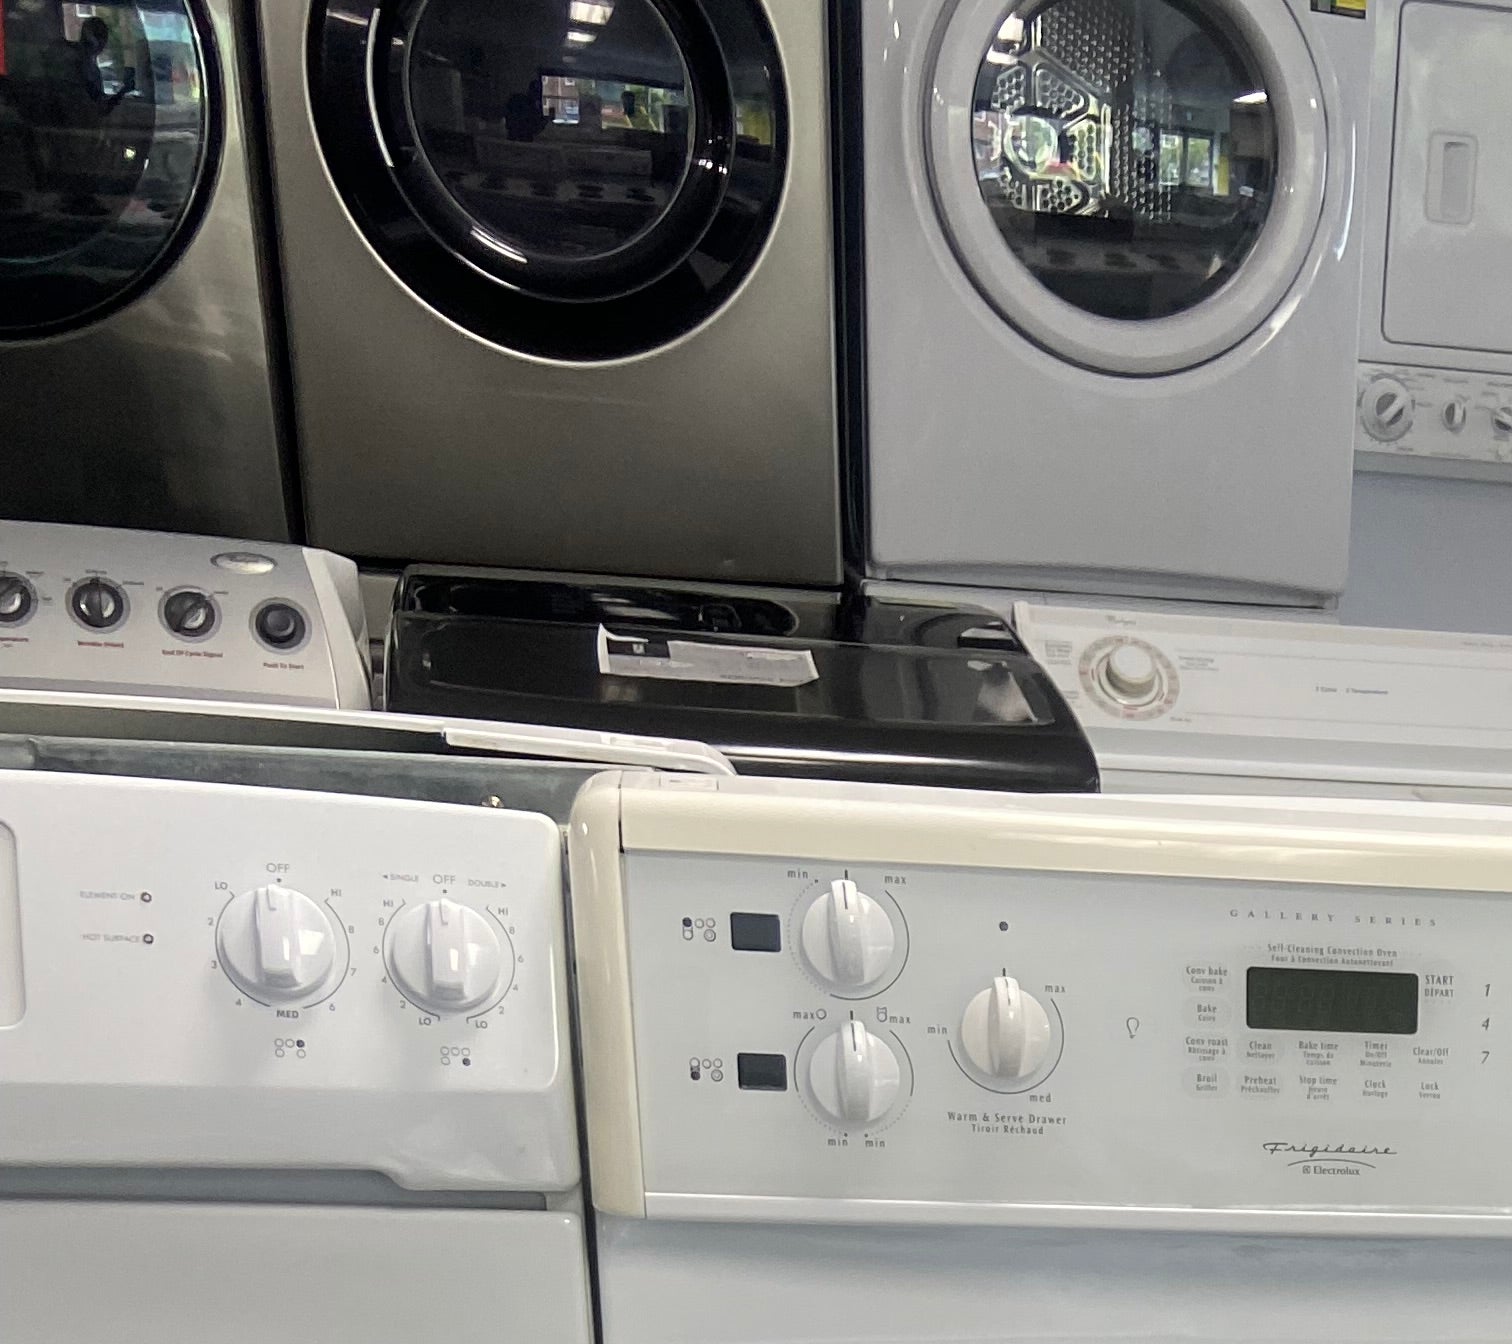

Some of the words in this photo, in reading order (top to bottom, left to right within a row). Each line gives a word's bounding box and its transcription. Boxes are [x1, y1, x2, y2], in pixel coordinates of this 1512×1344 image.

[266, 863, 290, 873] OFF
[787, 870, 808, 879] min
[390, 874, 419, 882] SINGLE
[432, 874, 456, 884] OFF
[468, 879, 499, 888] DOUBLE
[884, 875, 907, 885] max
[214, 881, 228, 890] LO
[330, 888, 342, 897] HI
[498, 907, 509, 916] HI
[207, 917, 214, 926] 2
[1229, 907, 1336, 922] GALLERY
[1354, 914, 1437, 927] SERIES
[1376, 948, 1398, 958] Oven
[1186, 966, 1205, 976] Conv
[1208, 967, 1228, 976] bake
[1425, 974, 1454, 986] START
[1045, 984, 1066, 993] max
[1484, 983, 1491, 998] 1
[1197, 1004, 1217, 1013] Bake
[276, 1010, 299, 1019] MED
[792, 1011, 815, 1020] max
[418, 1017, 432, 1026] LO
[889, 1016, 911, 1024] max
[1481, 1017, 1490, 1031] 4
[475, 1020, 488, 1030] LO
[927, 1024, 948, 1034] min
[1186, 1036, 1205, 1046] Conv
[1249, 1041, 1272, 1050] Clean
[1298, 1041, 1318, 1050] Bake
[1321, 1042, 1339, 1050] time
[1364, 1041, 1388, 1050] Timer
[1413, 1047, 1449, 1057] Clear/Off
[1481, 1050, 1490, 1065] 7
[1197, 1074, 1217, 1083] Broil
[1244, 1075, 1276, 1085] Preheat
[1299, 1076, 1317, 1086] Stop
[1319, 1076, 1338, 1085] time
[1364, 1080, 1386, 1089] Clock
[1421, 1082, 1439, 1091] Lock
[1029, 1093, 1052, 1103] med
[947, 1111, 978, 1122] Warm
[982, 1112, 991, 1122] &
[995, 1113, 1024, 1123] Serve
[1028, 1114, 1067, 1125] Drawer
[971, 1124, 999, 1133] Tiroir
[827, 1138, 848, 1147] min
[865, 1139, 885, 1148] min
[1262, 1142, 1398, 1158] Frigidaire
[1313, 1165, 1360, 1176] Electrolux
